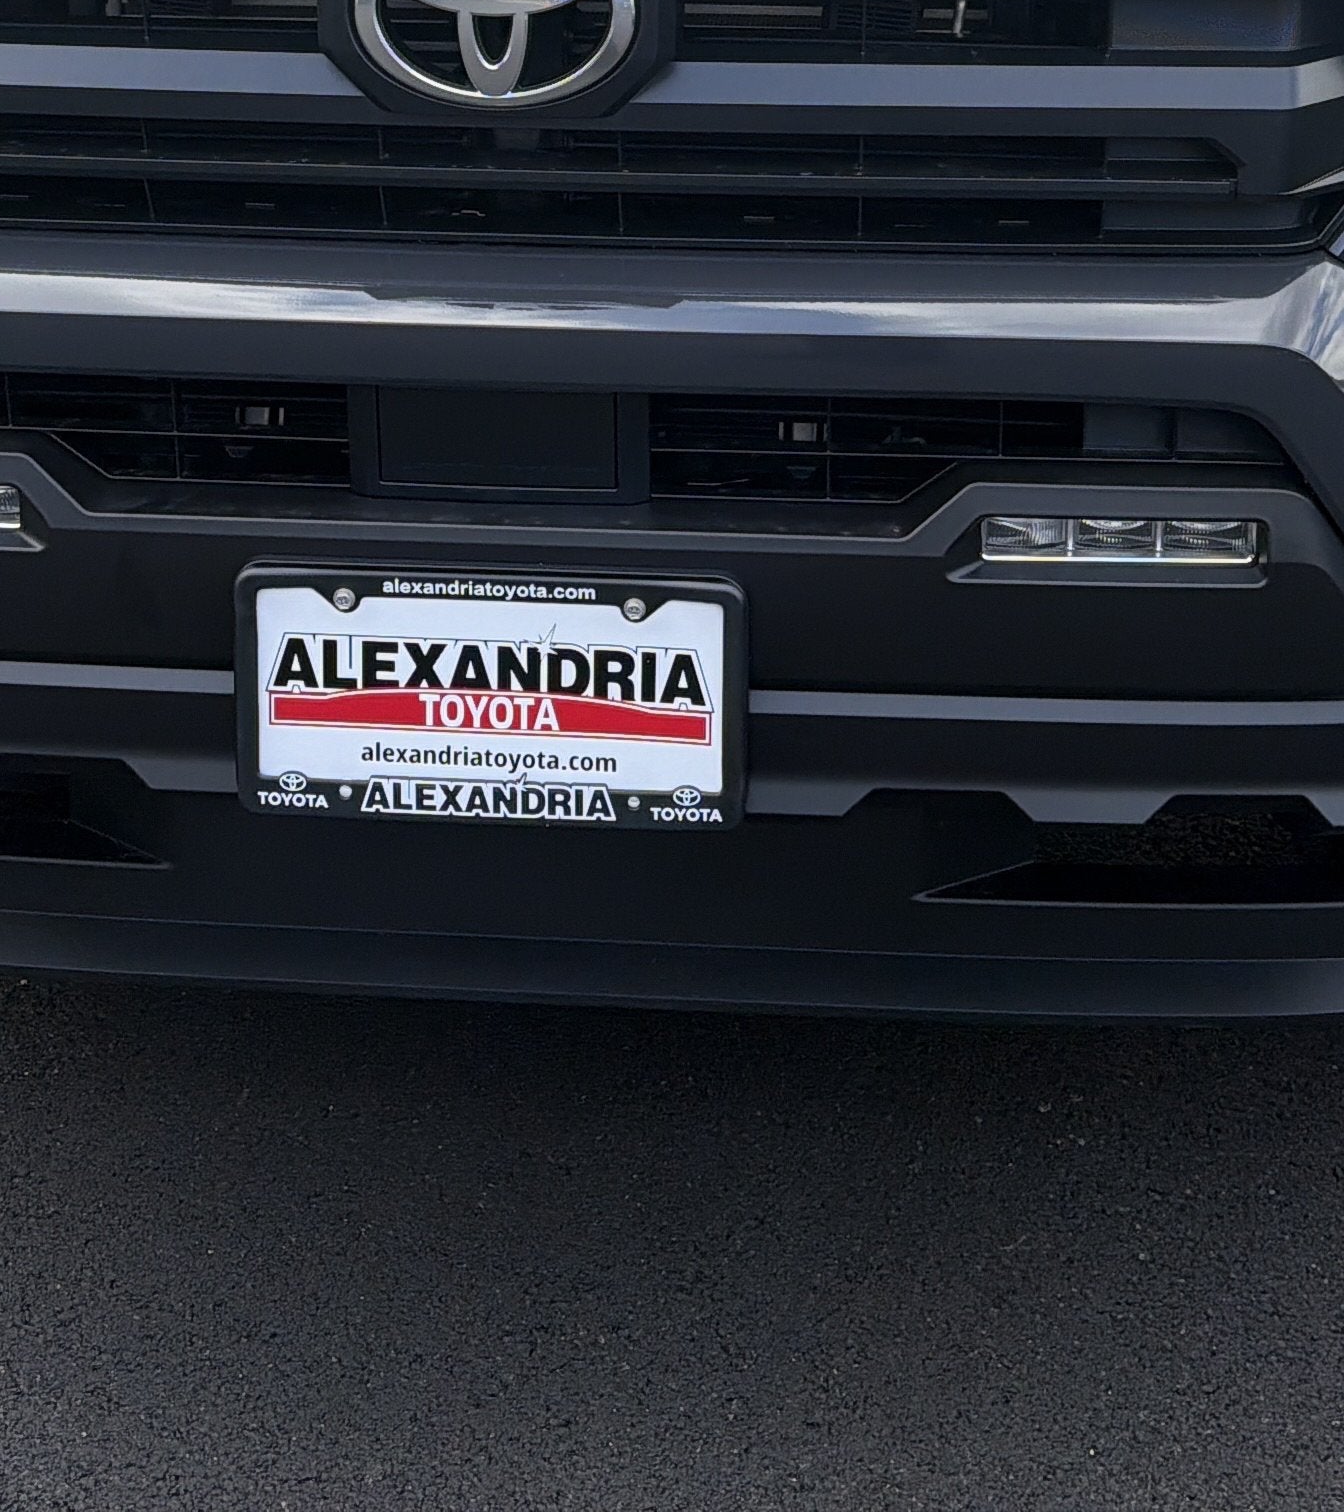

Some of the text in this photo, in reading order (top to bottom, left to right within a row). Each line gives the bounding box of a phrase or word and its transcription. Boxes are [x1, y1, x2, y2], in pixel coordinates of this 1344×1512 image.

[382, 578, 597, 601] alexandriatoyota.com
[272, 637, 707, 706] ALEXANDRIA
[419, 693, 561, 732] TOYOTA
[360, 741, 618, 774] alexandriatoyota.com
[257, 791, 329, 810] TOYOTA
[362, 779, 615, 820] ALEXANDRIA
[650, 806, 723, 823] TOYOTA
